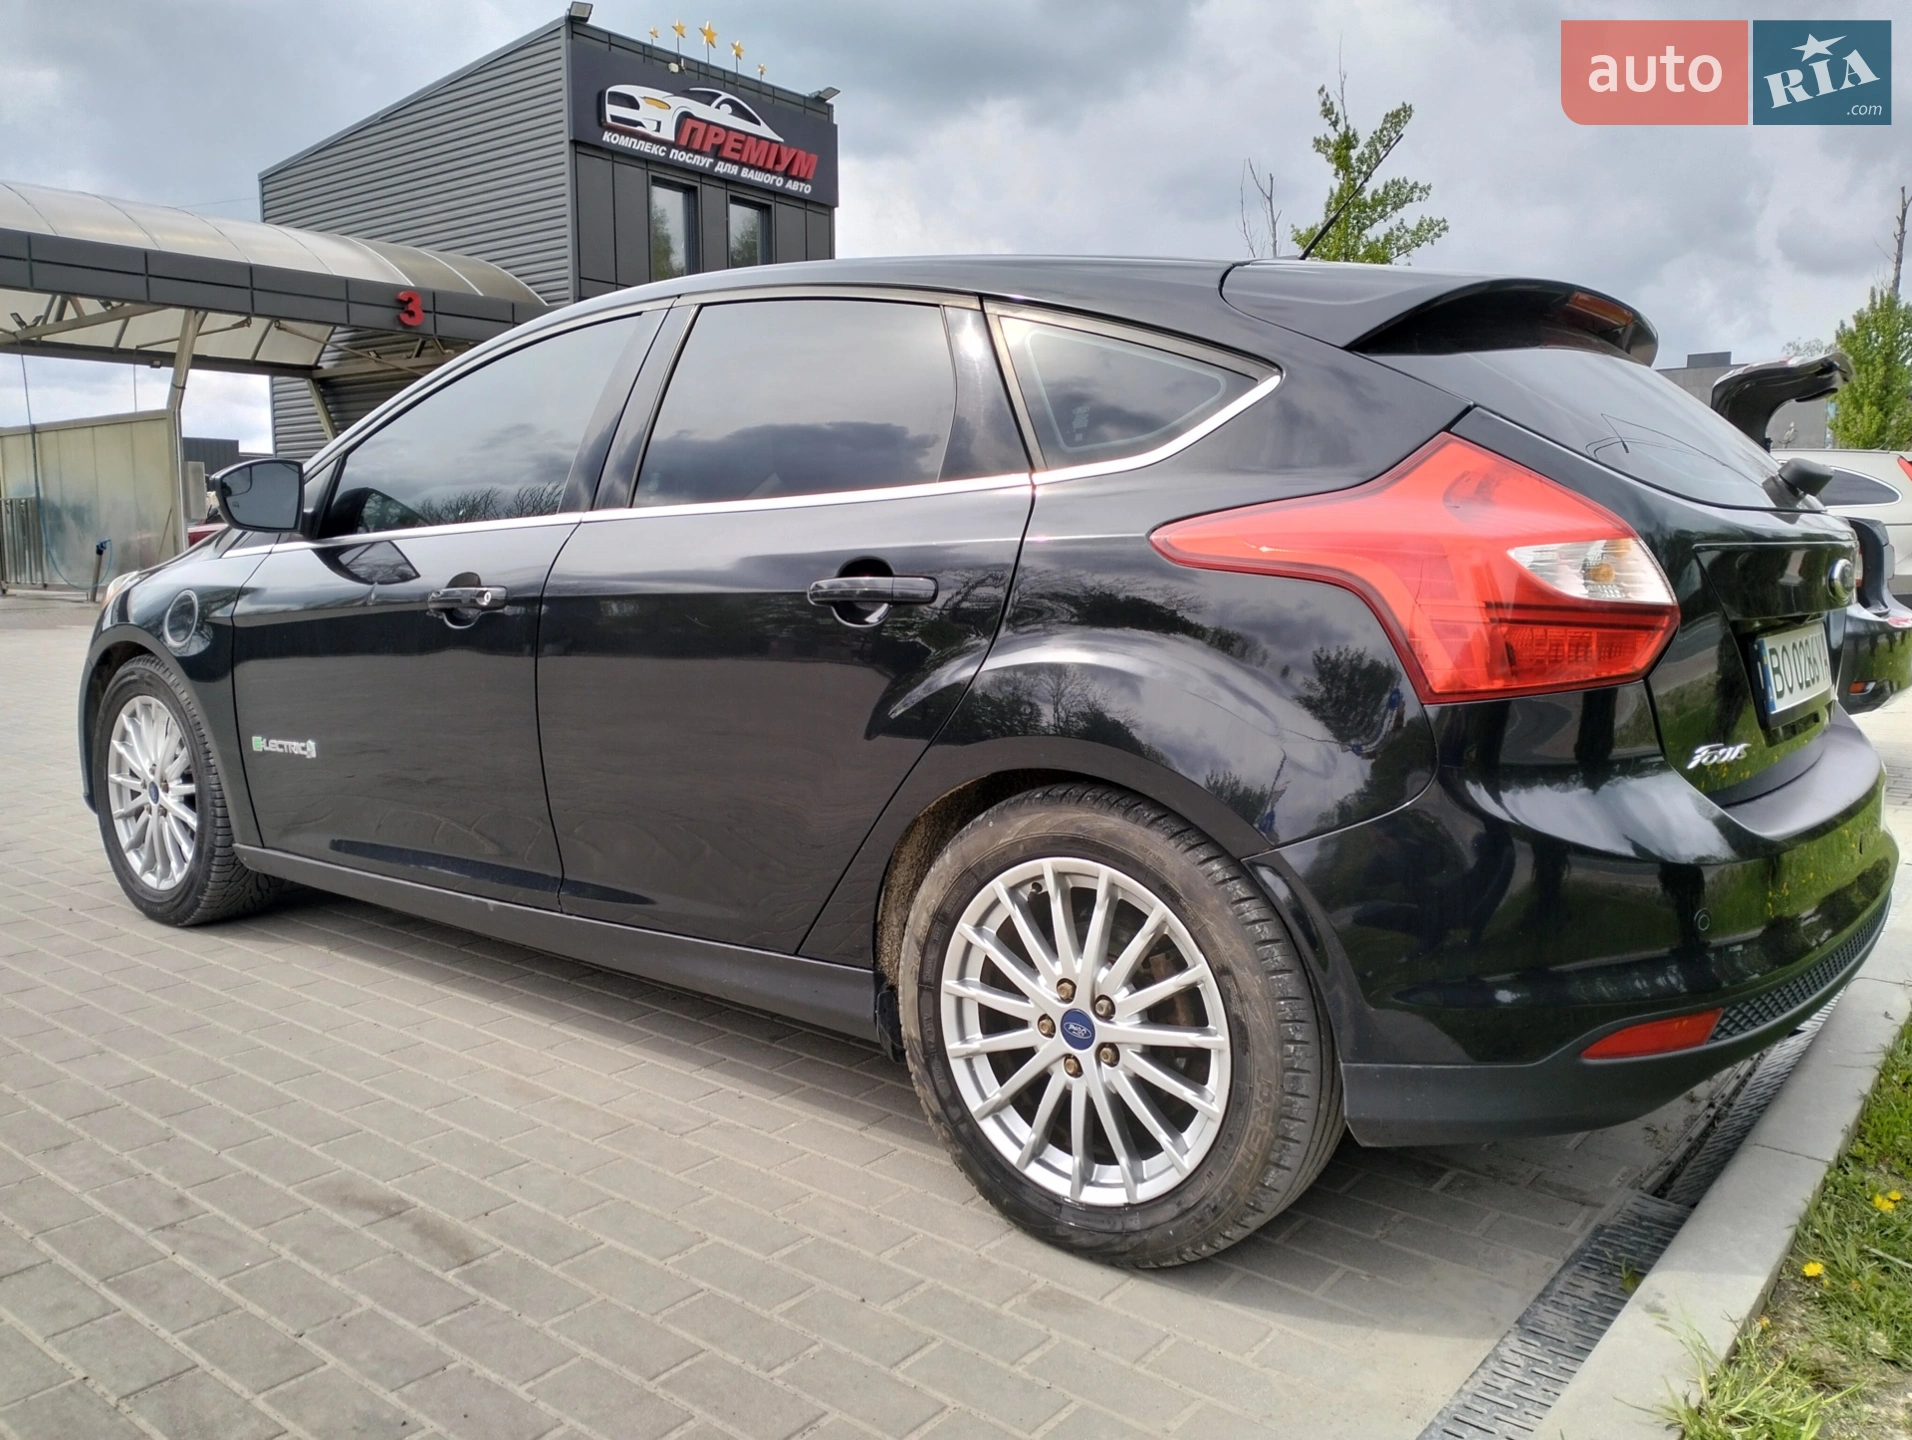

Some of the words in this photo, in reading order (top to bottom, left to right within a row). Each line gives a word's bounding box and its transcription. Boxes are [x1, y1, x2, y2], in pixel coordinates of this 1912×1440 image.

[602, 131, 667, 156] КОМПЛЕКС
[669, 148, 714, 169] ПОСЛУГ
[714, 161, 738, 175] ДЛЯ
[741, 167, 783, 188] ВАШОГО
[785, 178, 812, 195] АВТО
[677, 117, 818, 179] ПРЕМІУМ
[396, 289, 425, 327] 3
